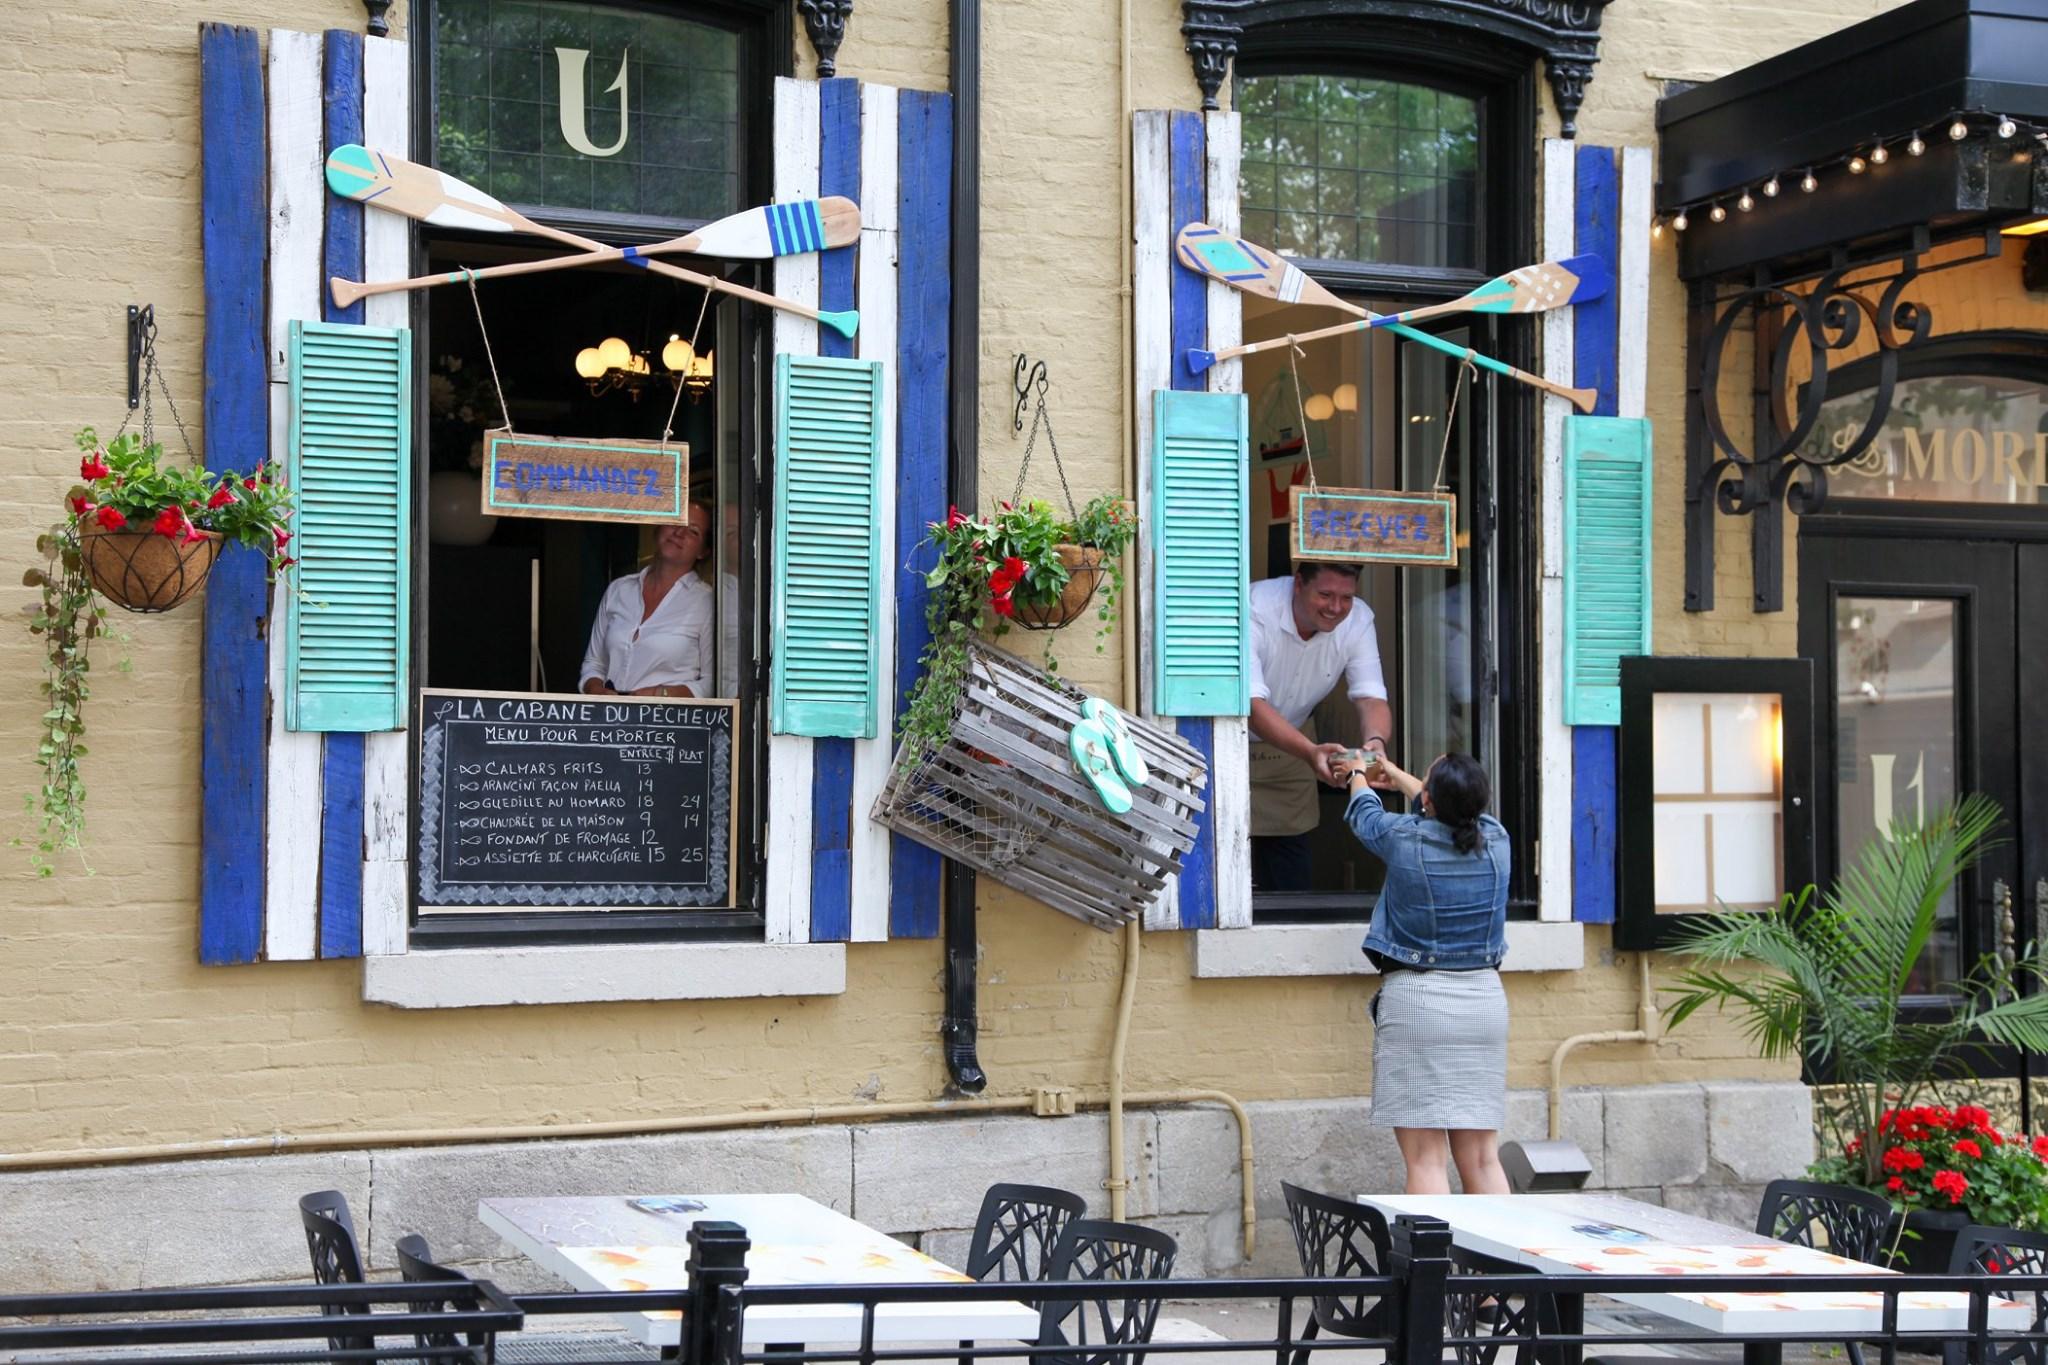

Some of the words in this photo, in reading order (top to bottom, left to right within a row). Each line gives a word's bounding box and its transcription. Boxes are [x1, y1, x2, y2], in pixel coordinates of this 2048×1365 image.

[554, 47, 628, 157] U
[494, 460, 663, 497] COMMANDEZ
[457, 699, 485, 719] LA
[499, 701, 595, 721] CABANE
[605, 705, 629, 722] DU
[485, 726, 528, 741] MENU
[540, 726, 578, 742] POUR
[590, 730, 676, 744] EMPORTER
[679, 749, 704, 760] PLAT
[485, 761, 556, 775] CALMARS
[563, 762, 603, 774] FRITS
[638, 763, 652, 775] 13
[481, 778, 536, 792] ARANCINI
[540, 781, 579, 793] FAÇON
[584, 779, 621, 792] PAELLA
[639, 779, 653, 793] 14
[482, 795, 543, 810] GUEDILLE
[548, 798, 563, 808] AU
[570, 797, 626, 808] HOMARD
[638, 795, 654, 808] 18
[680, 795, 700, 808] 24
[541, 817, 556, 828] DE
[560, 817, 573, 827] LA
[577, 814, 625, 828] MAISON
[639, 811, 651, 827] 9
[684, 814, 699, 829] 14
[487, 831, 550, 845] FONDANT
[555, 833, 570, 845] DE
[577, 832, 631, 846] FROMAGE
[641, 829, 659, 845] 12
[483, 849, 542, 863] ASSIETTE
[549, 852, 566, 863] DE
[568, 846, 642, 864] CHARCUTERIE
[648, 847, 666, 863] 15
[681, 848, 703, 863] 25
